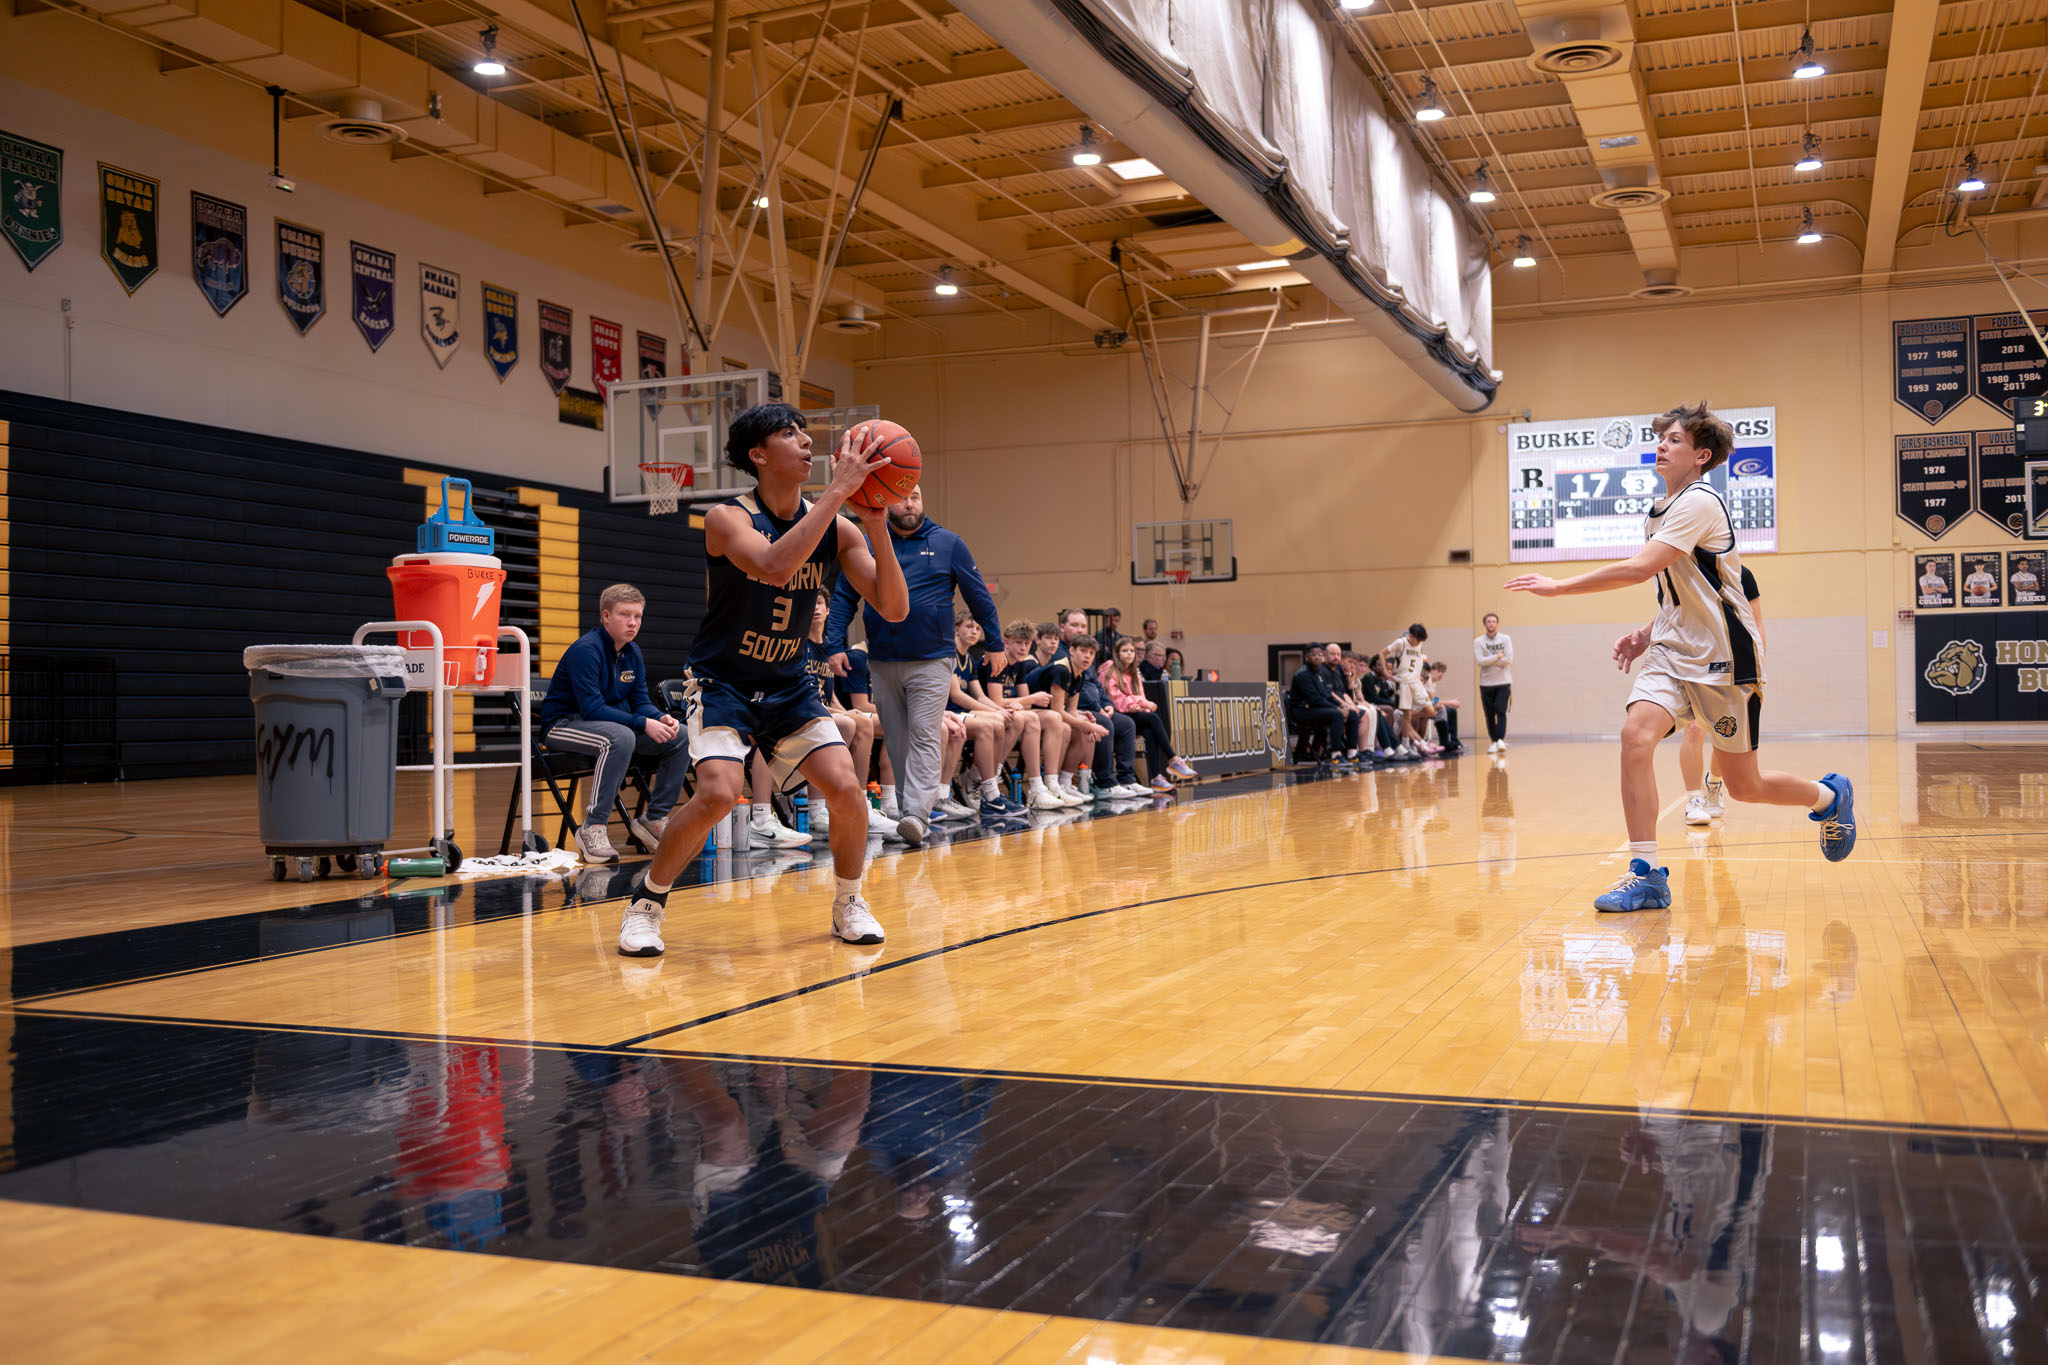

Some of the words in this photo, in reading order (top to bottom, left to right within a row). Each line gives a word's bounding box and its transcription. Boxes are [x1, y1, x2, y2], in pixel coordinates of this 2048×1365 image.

[2, 141, 54, 166] OMAHA
[0, 157, 57, 183] BENSON
[105, 172, 152, 198] OMAHA
[197, 201, 241, 224] OMAHA
[3, 214, 59, 242] BUNNIES
[281, 227, 320, 248] OMAHA
[356, 250, 391, 270] OMAHA
[355, 263, 394, 283] CENTRAL
[424, 269, 456, 288] OMAHA
[1992, 316, 2028, 328] FOOTBA
[1907, 352, 1929, 361] 1977
[1936, 350, 1958, 359] 1986
[2001, 345, 2024, 354] 2018
[1987, 375, 2009, 384] 1980
[2018, 373, 2041, 382] 1984
[2003, 382, 2026, 391] 2011
[1908, 384, 1930, 393] 1993
[1936, 382, 1958, 391] 2000
[1516, 431, 1595, 450] BURKE
[1901, 438, 1921, 449] GIRLS
[1923, 433, 1967, 447] BASKETBALL
[1520, 468, 1544, 489] B
[1923, 466, 1946, 475] 1978
[1570, 473, 1609, 499] 17
[1634, 479, 1645, 491] 3
[1924, 498, 1947, 508] 1977
[448, 532, 490, 545] POWERADE
[467, 568, 495, 580] BURKE
[1918, 597, 1953, 605] COLLINS
[2015, 595, 2047, 603] PARKS
[771, 596, 793, 632] 3
[738, 630, 801, 663] SOUTH
[1408, 659, 1417, 673] 5
